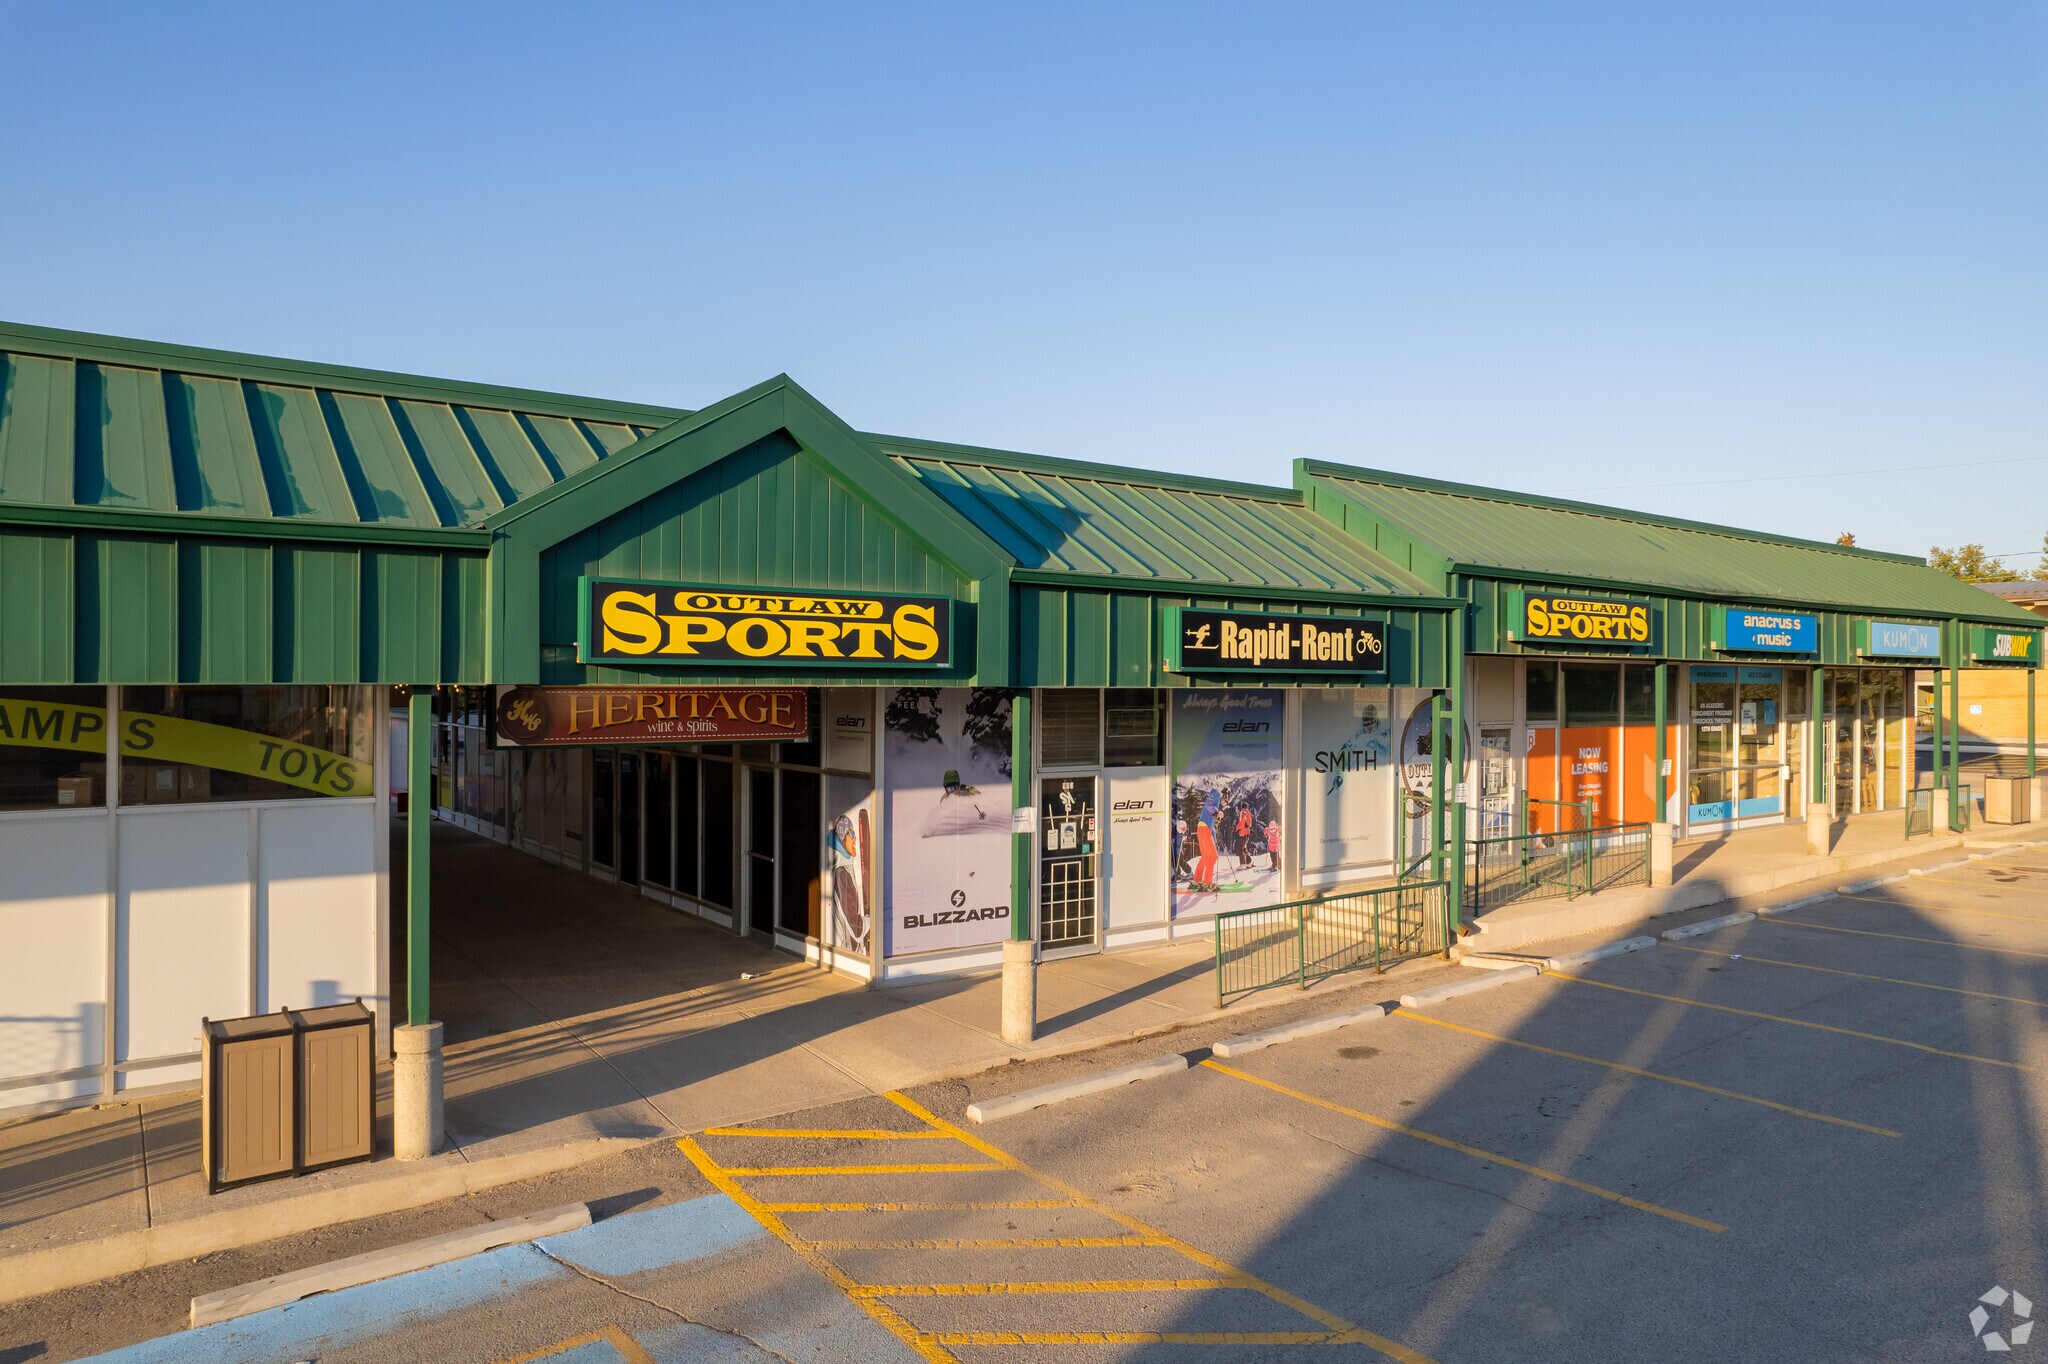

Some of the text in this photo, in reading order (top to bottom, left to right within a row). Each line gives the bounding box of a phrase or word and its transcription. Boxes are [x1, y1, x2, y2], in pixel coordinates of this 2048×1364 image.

[687, 595, 872, 616] OUTLAW
[1557, 601, 1622, 614] OUTLAW
[601, 590, 939, 661] SPORTS
[1527, 598, 1648, 642] SPORTS
[1744, 614, 1802, 631] anacruss
[1221, 620, 1354, 666] Rapid-Rent
[1757, 632, 1792, 647] music
[1883, 627, 1928, 653] KUMON
[1993, 633, 2033, 658] SUBWAY
[1183, 693, 1273, 713] Always Good Times
[567, 692, 796, 736] HERITAGE
[836, 714, 866, 728] elan
[647, 719, 718, 735] wine & spirits
[1222, 719, 1270, 733] elan
[1315, 750, 1377, 774] SMITH
[1579, 747, 1602, 759] NOW
[259, 740, 358, 792] TOYS
[1571, 762, 1609, 775] LEASING
[1113, 800, 1154, 811] elan
[1697, 804, 1725, 818] KUMON
[903, 905, 1010, 930] BLIZZARD
